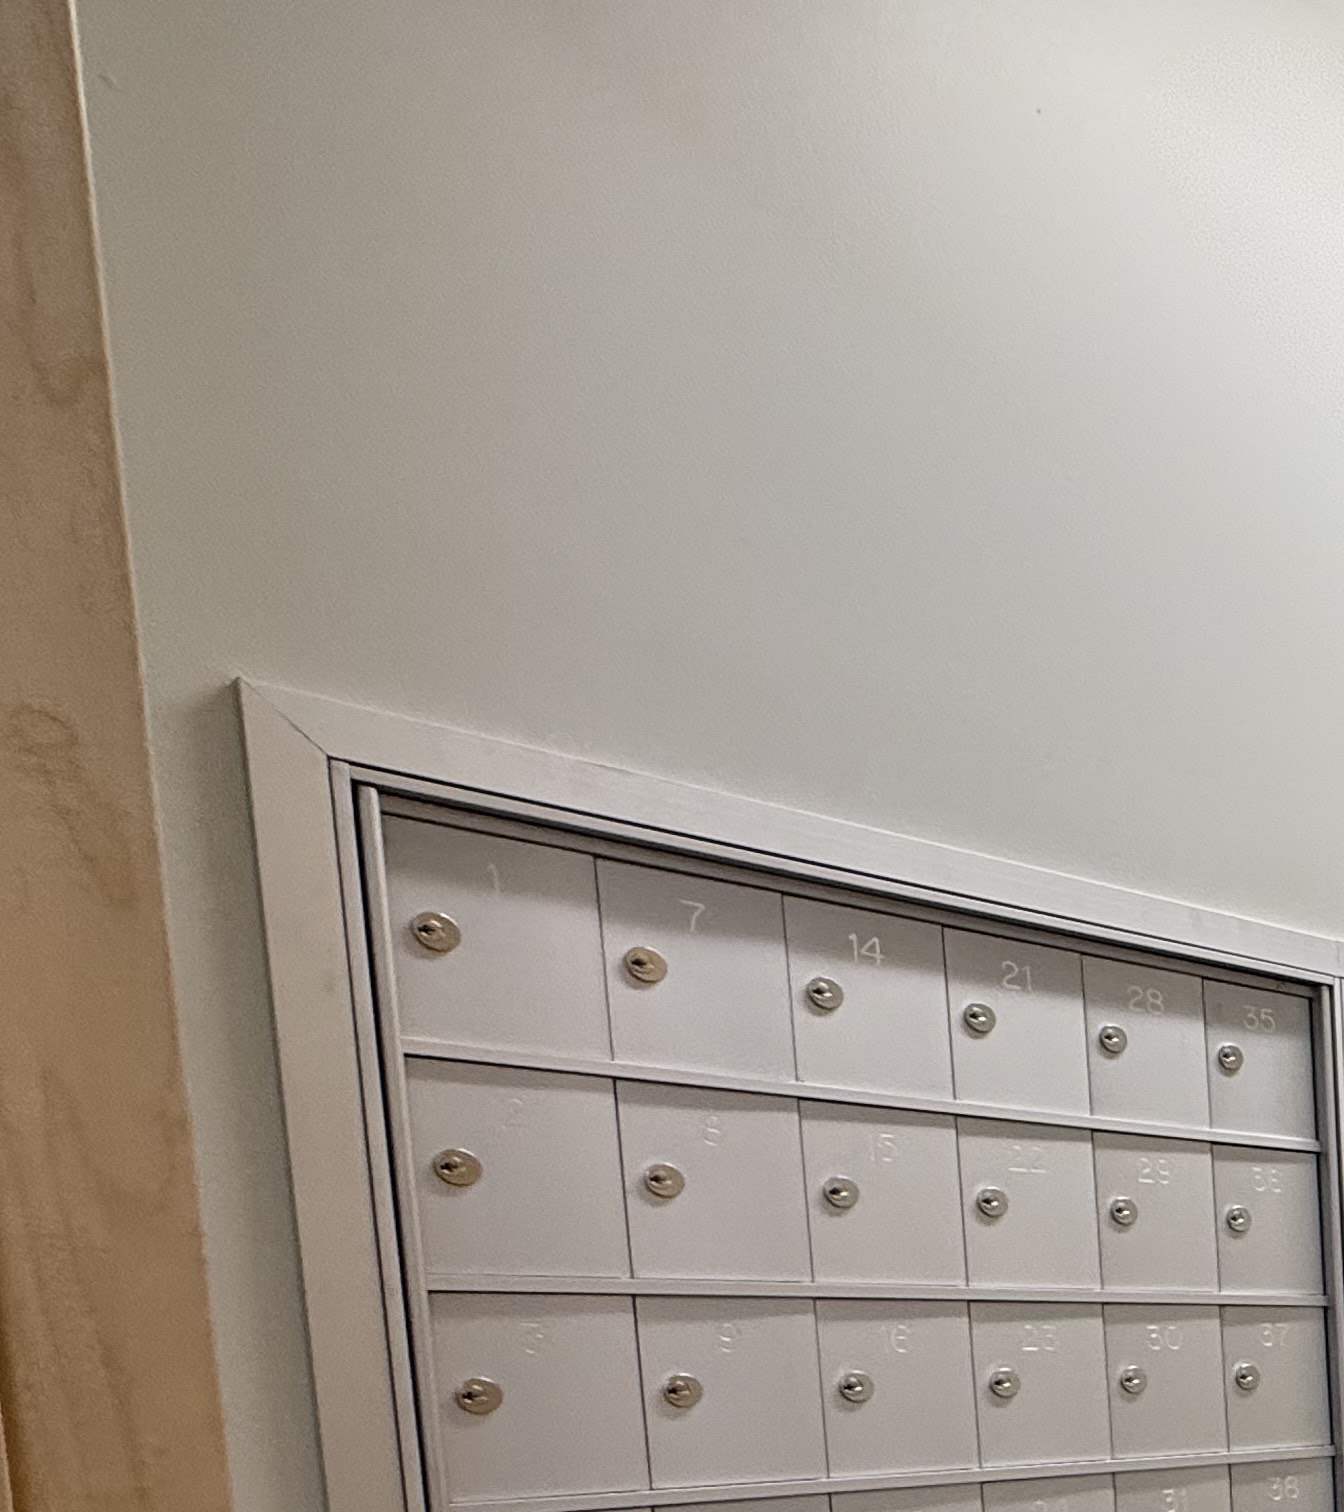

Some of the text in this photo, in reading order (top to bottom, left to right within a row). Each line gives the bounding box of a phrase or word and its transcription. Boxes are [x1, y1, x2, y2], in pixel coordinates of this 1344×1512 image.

[488, 863, 502, 899] 1
[677, 898, 707, 933] 7
[847, 931, 885, 966] 14
[1001, 960, 1034, 993] 21
[1126, 986, 1166, 1016] 28
[1241, 1004, 1277, 1034] 35
[868, 1133, 899, 1163] 15
[1146, 1323, 1184, 1351] 30
[1260, 1322, 1290, 1348] 37
[1267, 1475, 1301, 1502] 38
